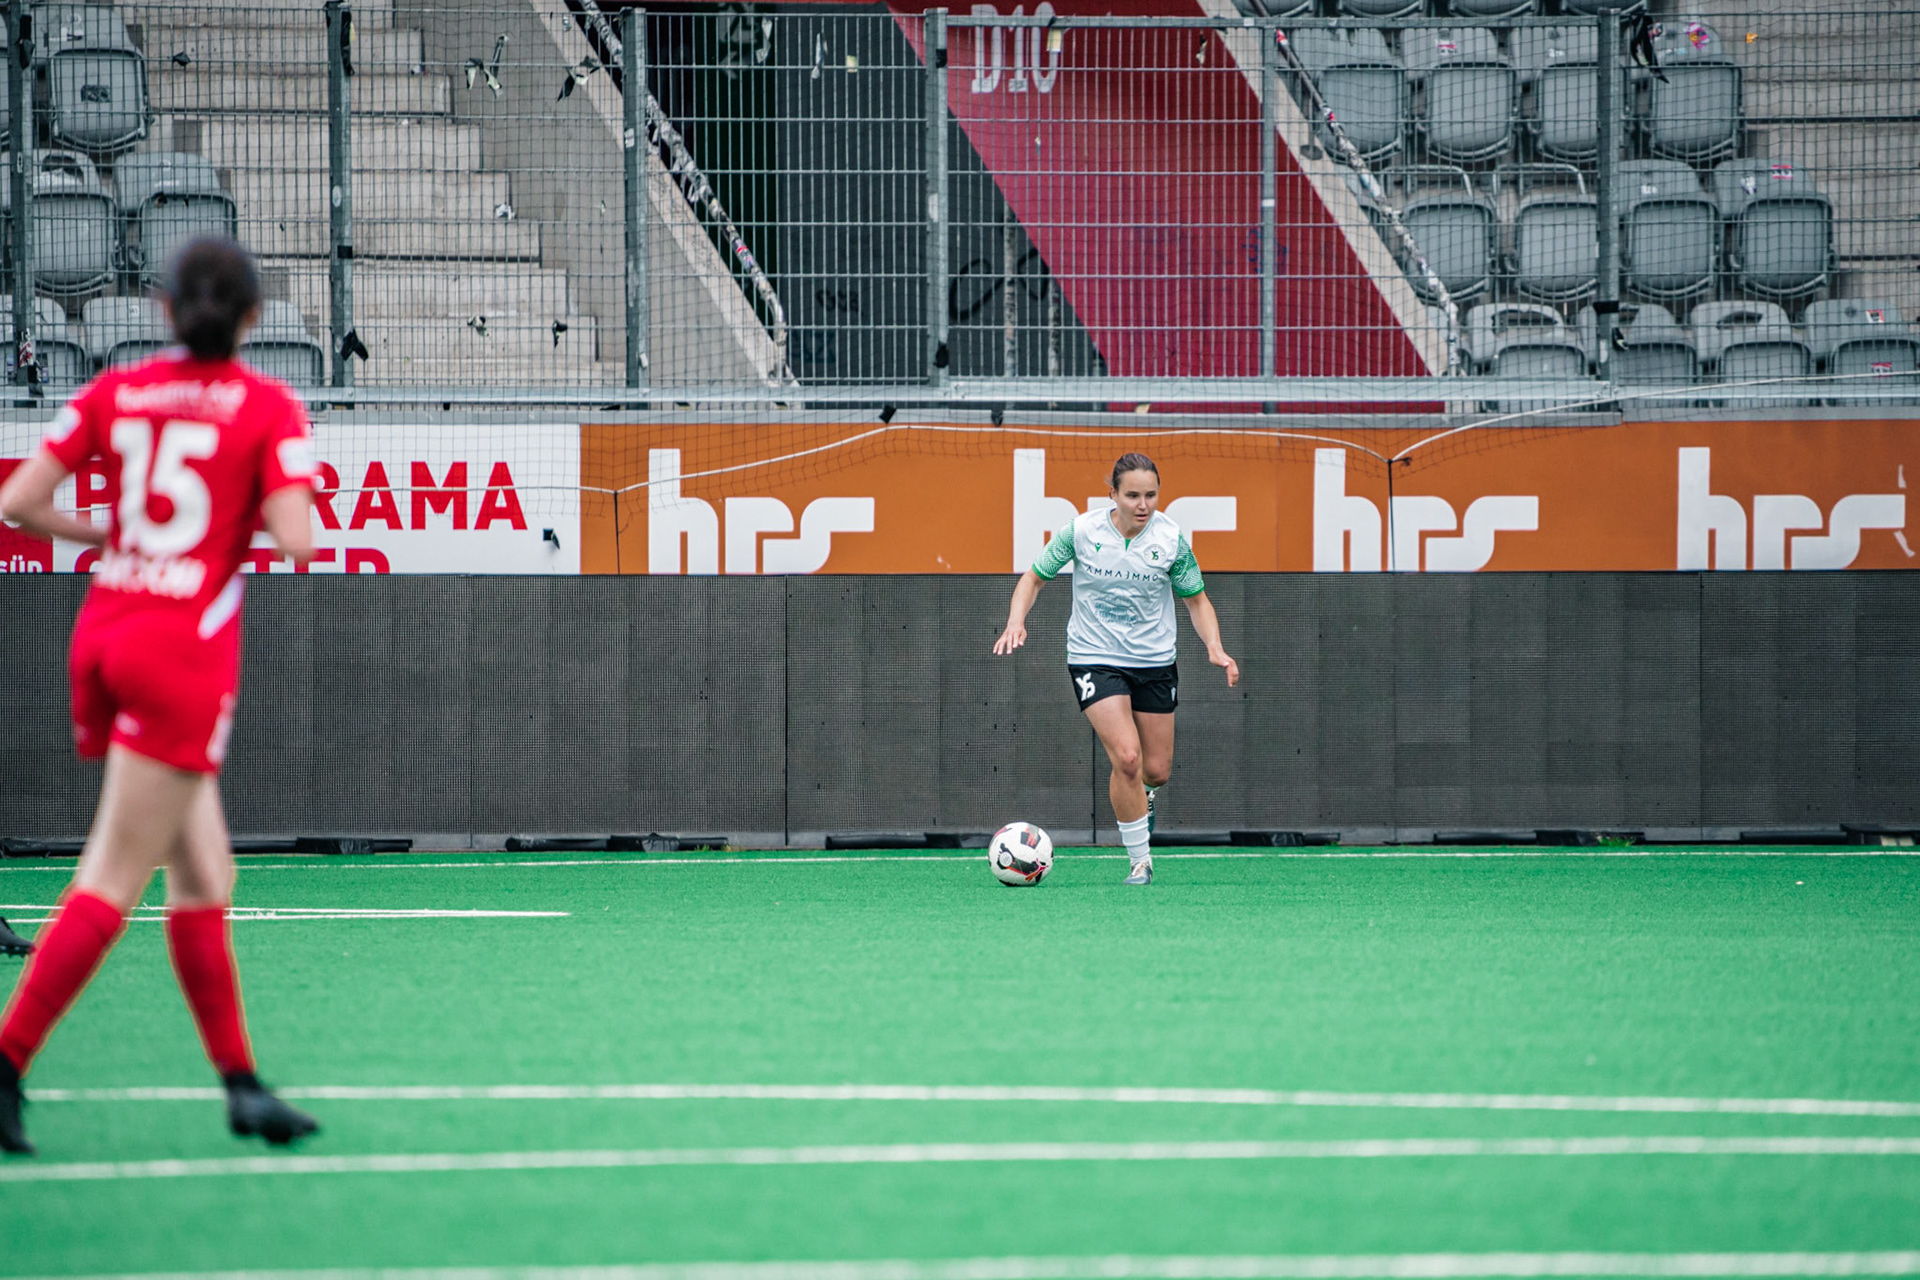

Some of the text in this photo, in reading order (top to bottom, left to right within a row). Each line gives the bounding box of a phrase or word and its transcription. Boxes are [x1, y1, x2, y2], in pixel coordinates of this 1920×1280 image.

[971, 2, 1058, 93] D10
[110, 417, 220, 557] 15
[648, 448, 874, 574] hrs
[1313, 447, 1539, 572] hrs
[1677, 446, 1906, 571] hrs
